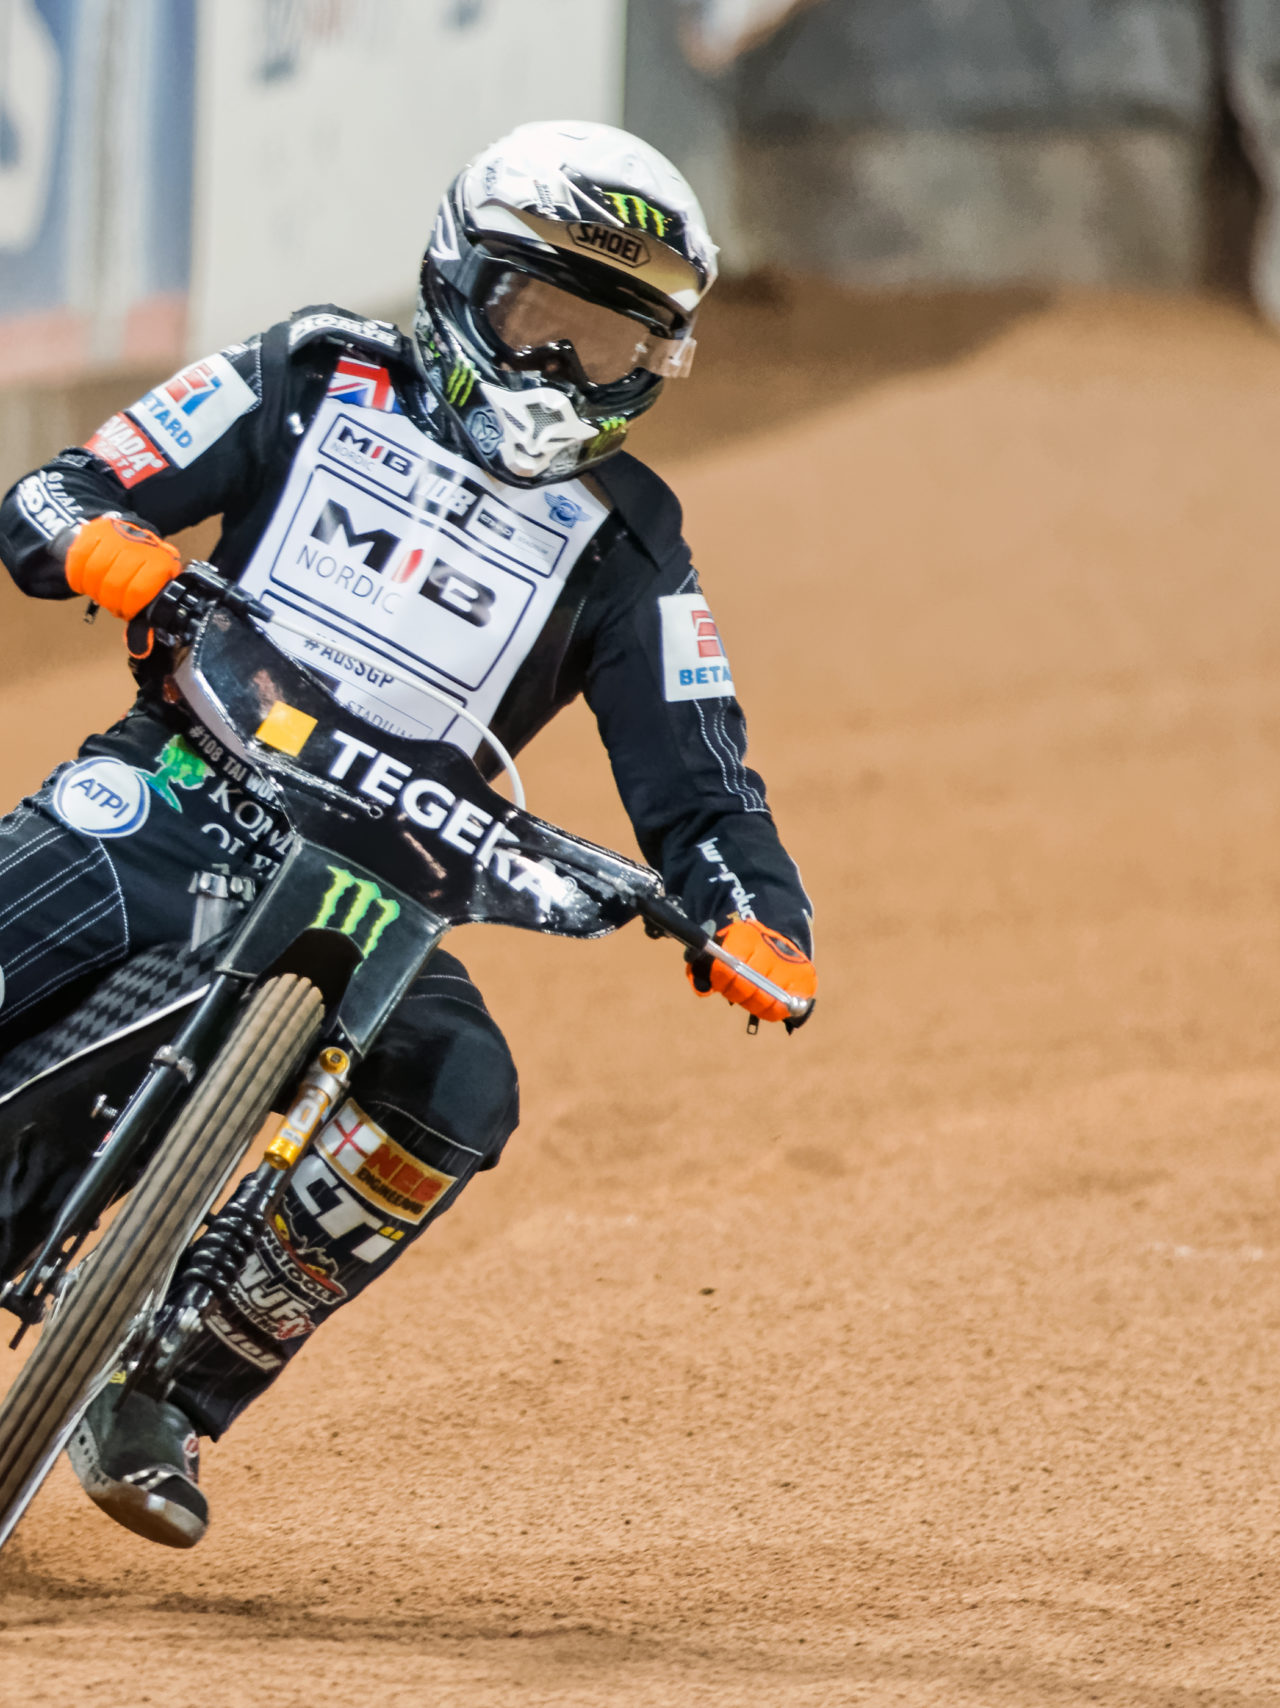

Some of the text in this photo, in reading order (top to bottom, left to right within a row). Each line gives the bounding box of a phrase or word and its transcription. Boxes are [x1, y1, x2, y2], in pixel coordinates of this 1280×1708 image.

[576, 223, 642, 263] SHOEI
[296, 544, 404, 615] NORDIC
[188, 725, 224, 762] #108
[222, 756, 247, 784] TAI
[72, 777, 130, 820] ATPI
